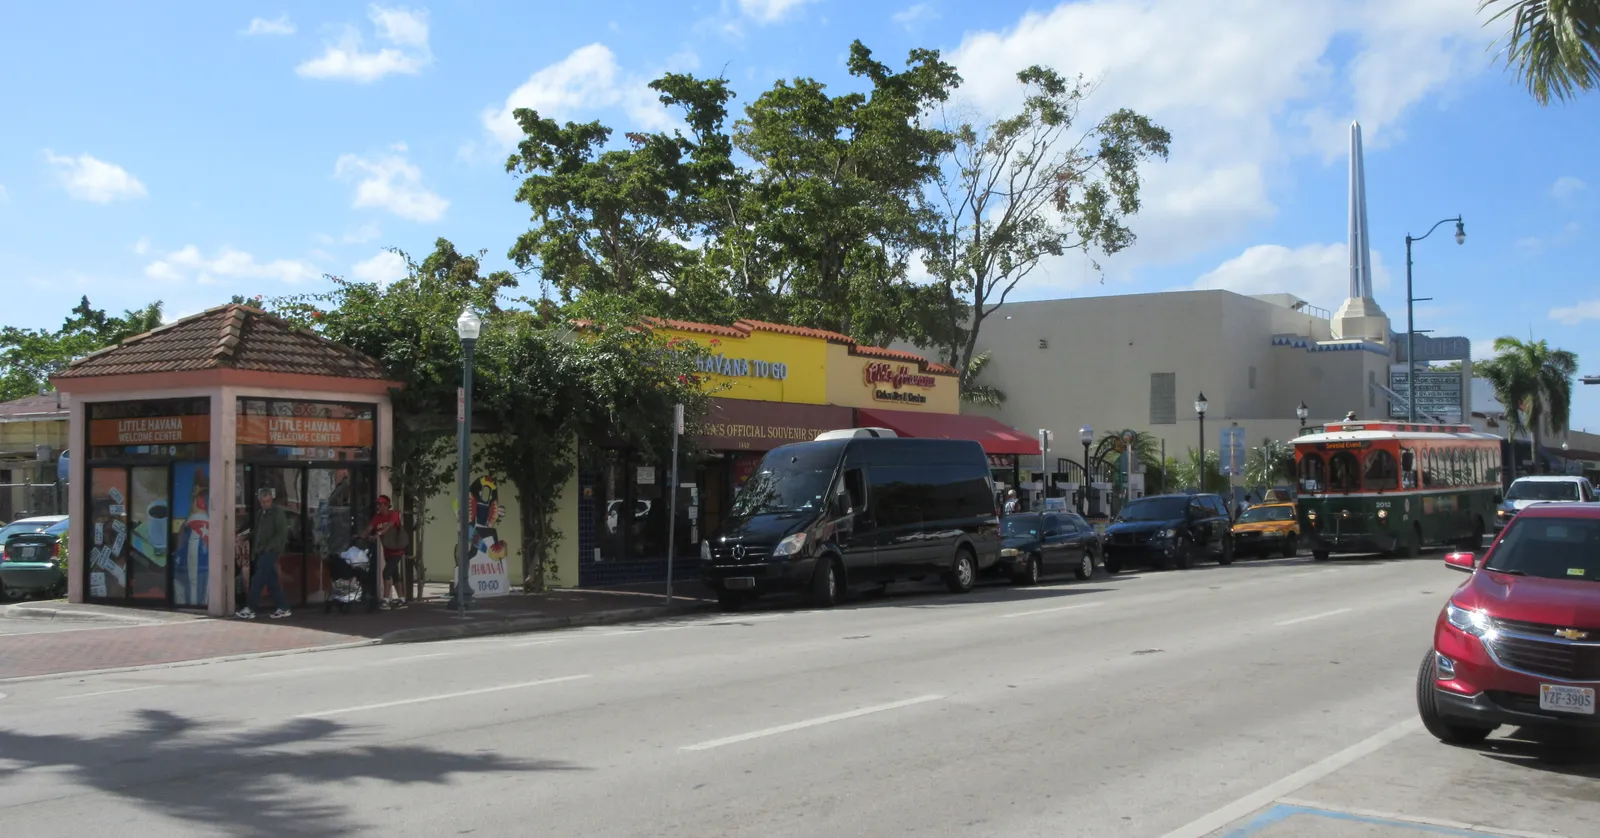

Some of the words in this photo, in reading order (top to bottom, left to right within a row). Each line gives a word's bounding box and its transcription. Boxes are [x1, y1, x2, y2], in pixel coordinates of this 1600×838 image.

[695, 352, 749, 376] HAVANA
[753, 360, 769, 377] TO
[772, 362, 788, 379] GO
[118, 420, 147, 432] LITTLE
[148, 418, 183, 430] HAVANA
[269, 419, 303, 431] LITTLE
[304, 421, 342, 432] HAVANA
[118, 431, 153, 442] WELCOME
[154, 430, 183, 441] CENTER
[269, 431, 310, 442] WELCOME
[311, 433, 341, 443] CENTER
[726, 424, 766, 438] OFFICIAL
[767, 426, 806, 440] SOUVENIR
[477, 579, 499, 591] TO-GO
